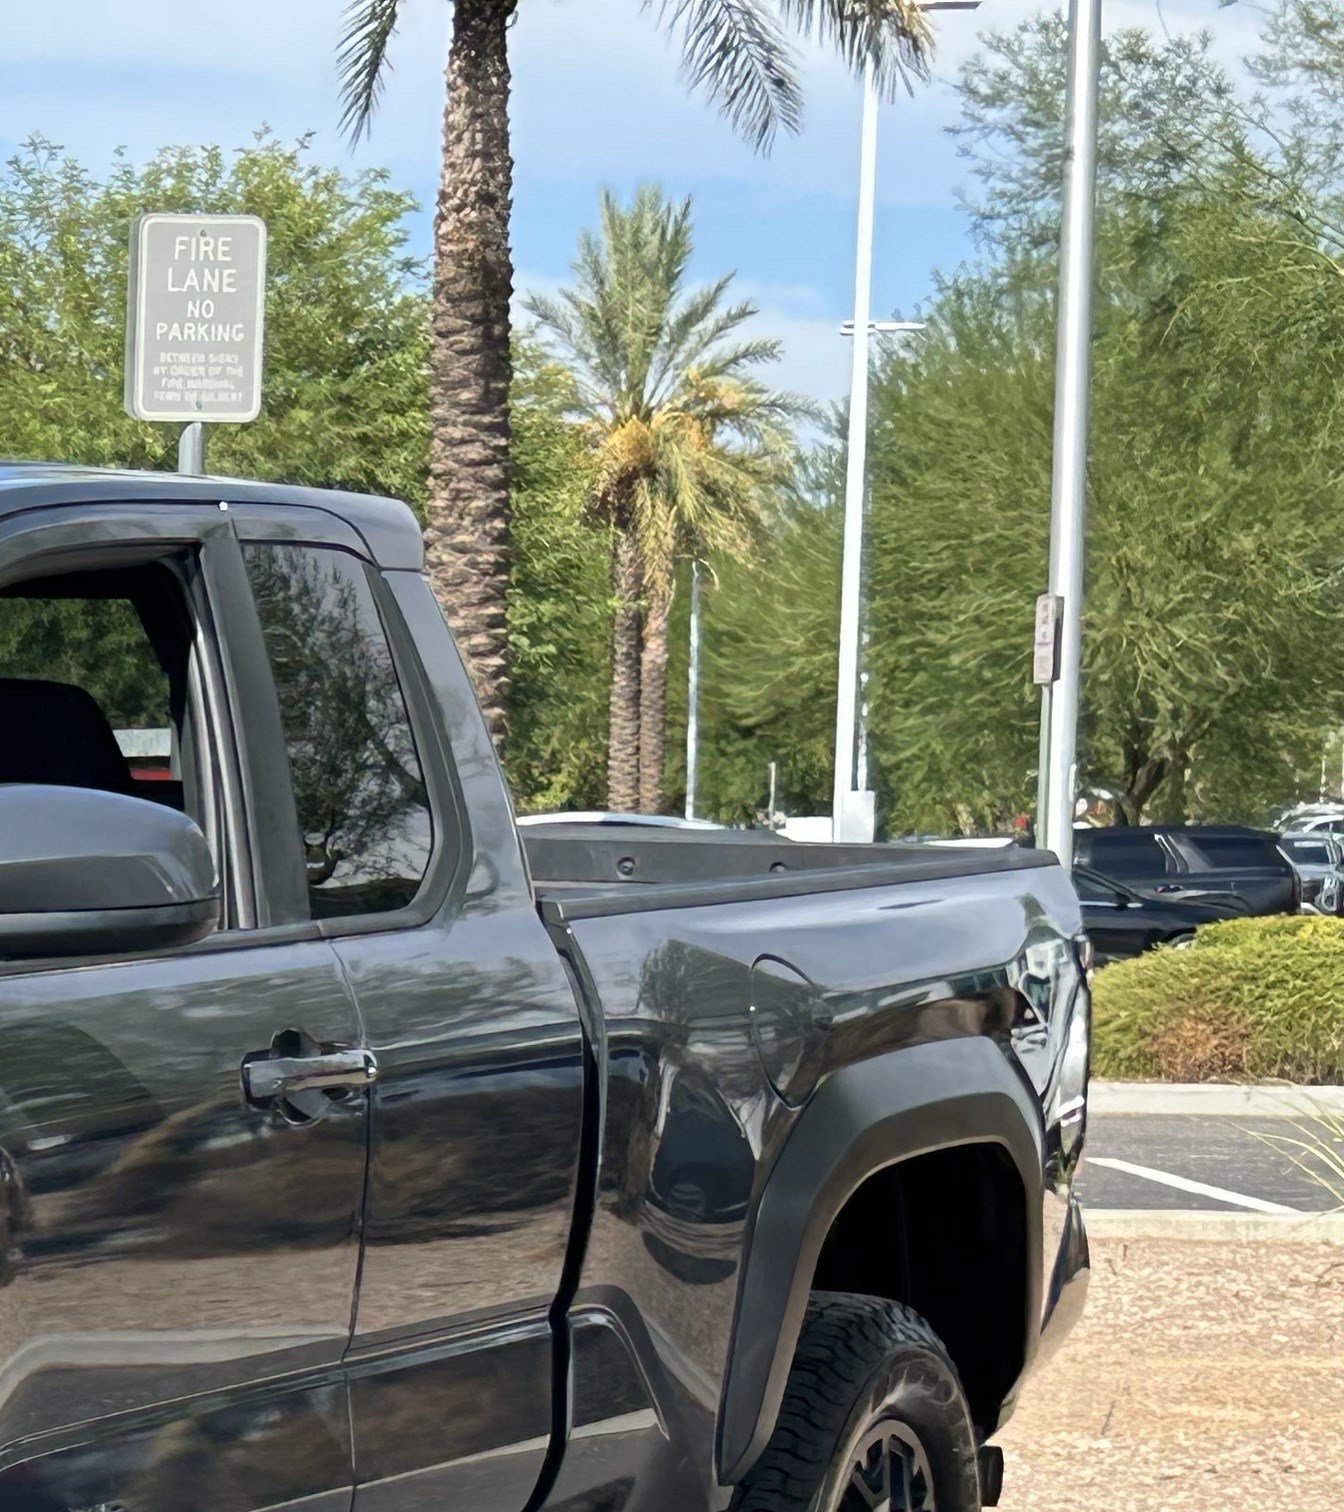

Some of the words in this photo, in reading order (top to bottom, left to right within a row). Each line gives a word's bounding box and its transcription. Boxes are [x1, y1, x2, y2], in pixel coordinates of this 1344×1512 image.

[174, 236, 233, 261] FIRE
[167, 267, 237, 293] LANE
[187, 299, 215, 319] NO
[155, 322, 245, 342] PARKING
